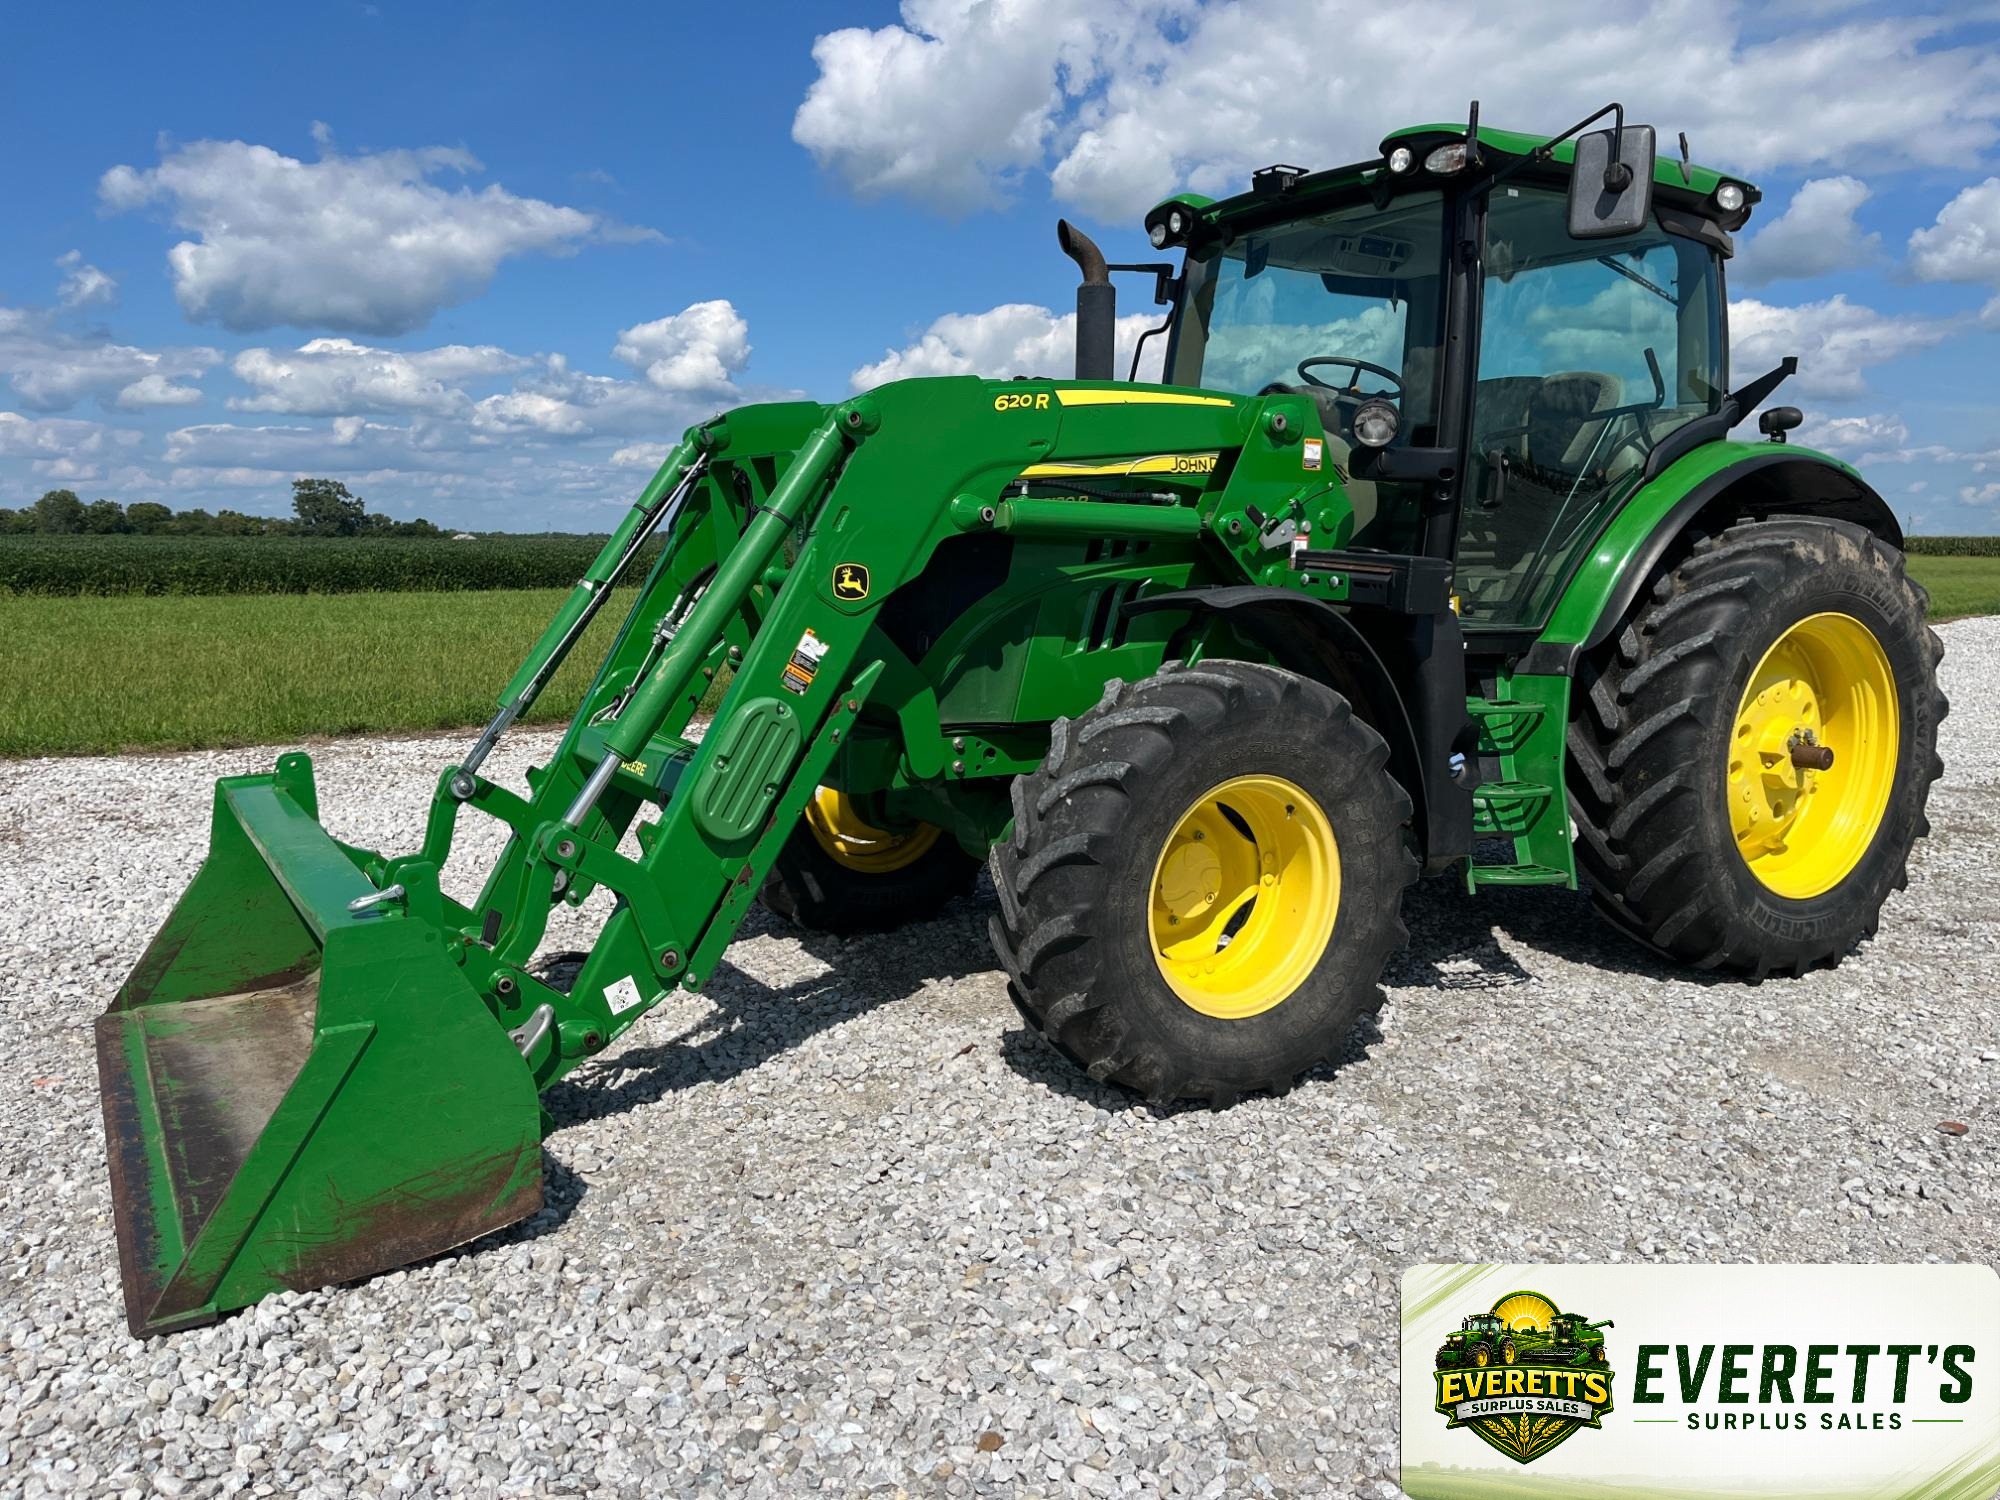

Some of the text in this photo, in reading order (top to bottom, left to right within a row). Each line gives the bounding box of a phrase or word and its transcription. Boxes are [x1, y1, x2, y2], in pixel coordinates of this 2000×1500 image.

[994, 393, 1049, 411] 620 R
[1170, 456, 1208, 471] JOHN
